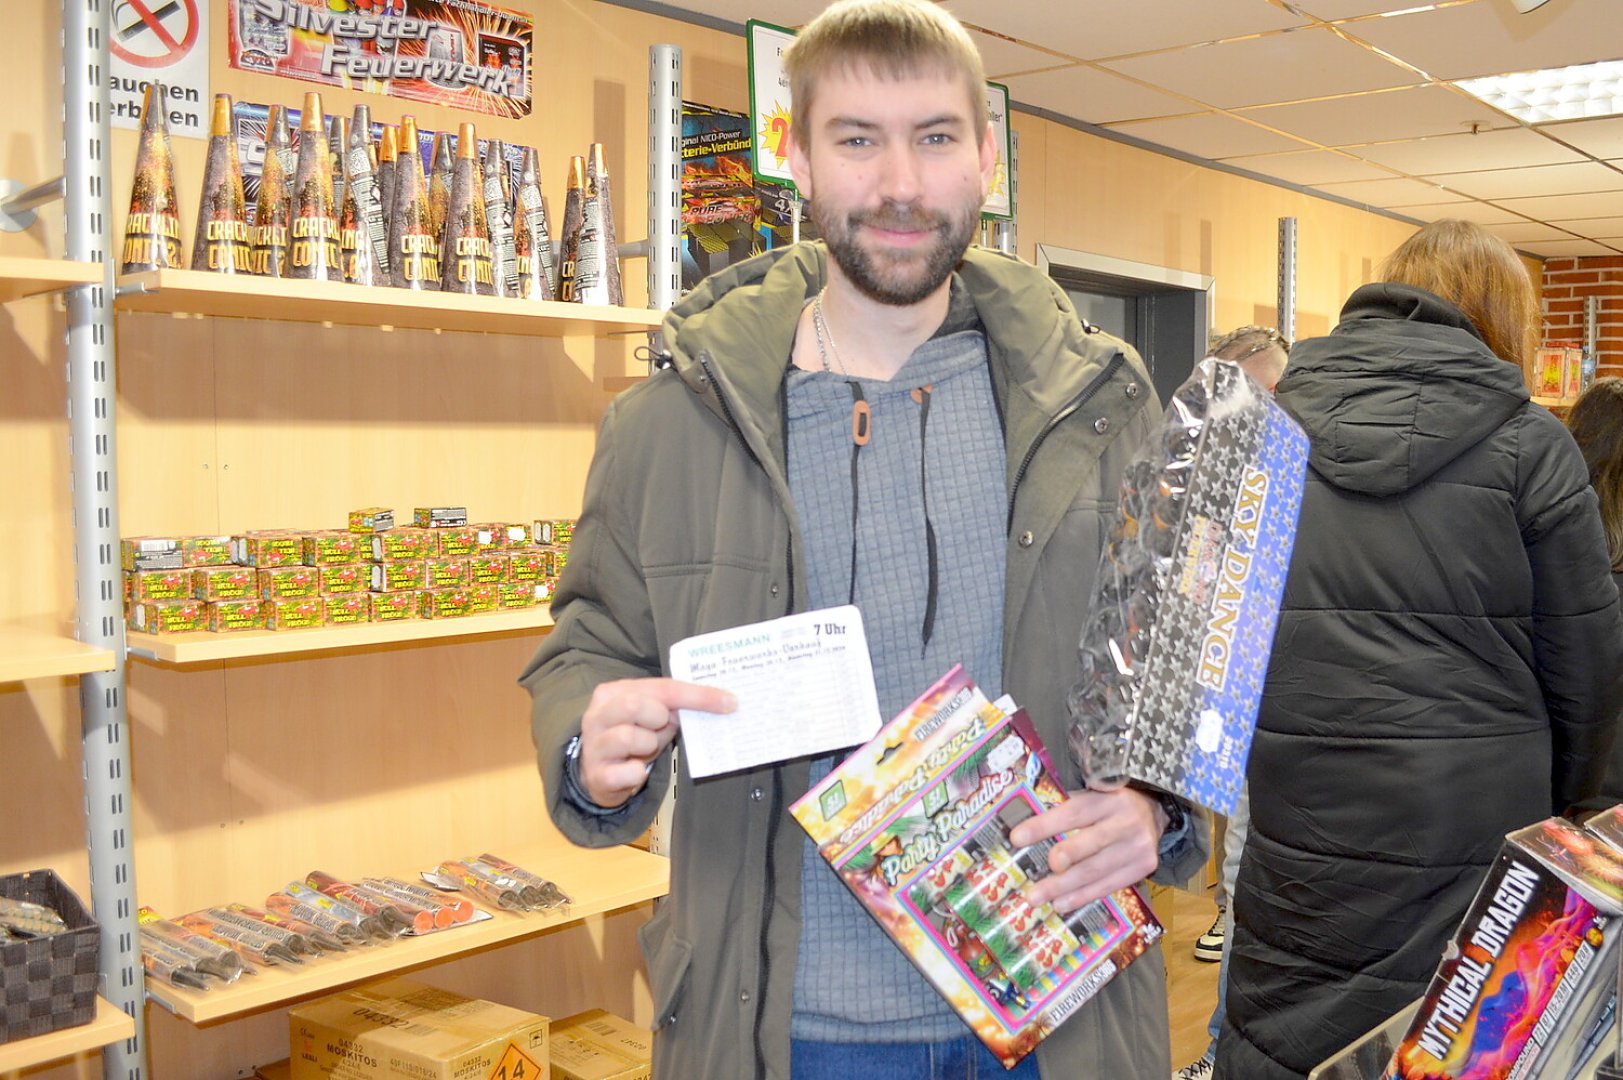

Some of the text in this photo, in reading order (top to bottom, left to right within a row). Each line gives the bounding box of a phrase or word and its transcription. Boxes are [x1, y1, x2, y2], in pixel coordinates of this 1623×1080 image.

[320, 43, 512, 97] Feuerwerk
[681, 136, 699, 150] ginal
[207, 220, 249, 242] CRACK
[1230, 466, 1268, 548] SKY
[813, 623, 847, 636] 7 Uhr
[1196, 543, 1254, 692] DANCE
[688, 634, 771, 658] WREESMANN
[933, 767, 1015, 843] Paradise
[882, 824, 943, 887] Party
[1471, 859, 1540, 957] DRAGON
[1418, 955, 1492, 1061] MYTHICAL
[326, 1042, 378, 1069] MOSKITOS
[453, 1058, 492, 1080] MOSKITOS
[1506, 1037, 1535, 1080] OMPOUND
